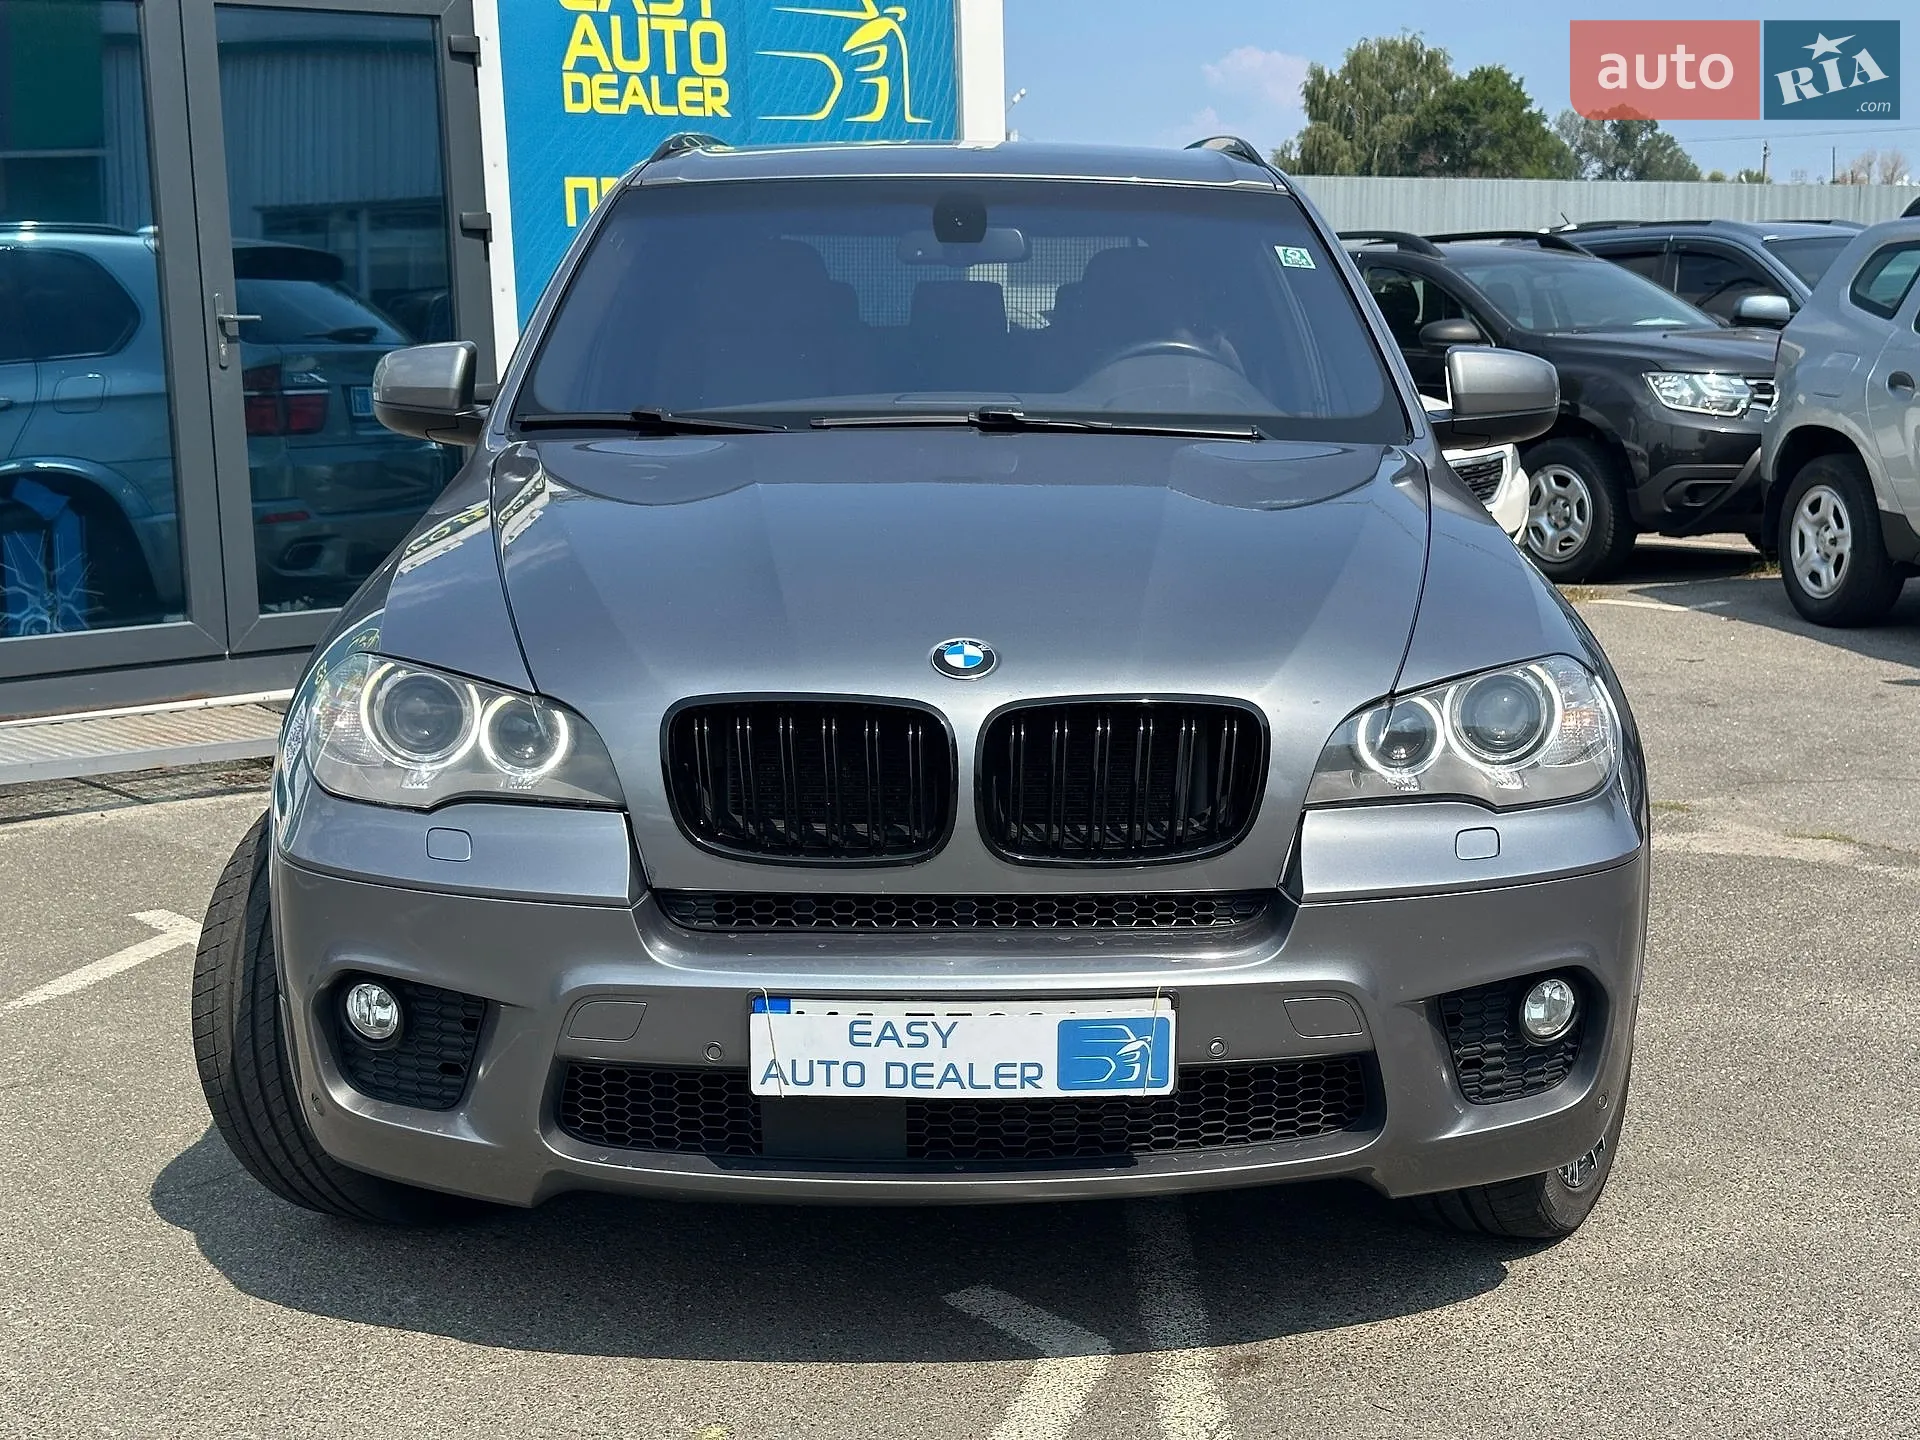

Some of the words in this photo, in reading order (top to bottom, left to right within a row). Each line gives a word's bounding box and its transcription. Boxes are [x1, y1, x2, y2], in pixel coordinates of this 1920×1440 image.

[562, 14, 728, 77] AUTO
[562, 73, 732, 118] DEALER
[564, 176, 619, 227] П
[848, 1020, 958, 1049] EASY
[760, 1059, 866, 1089] AUTO
[885, 1061, 1044, 1090] DEALER
